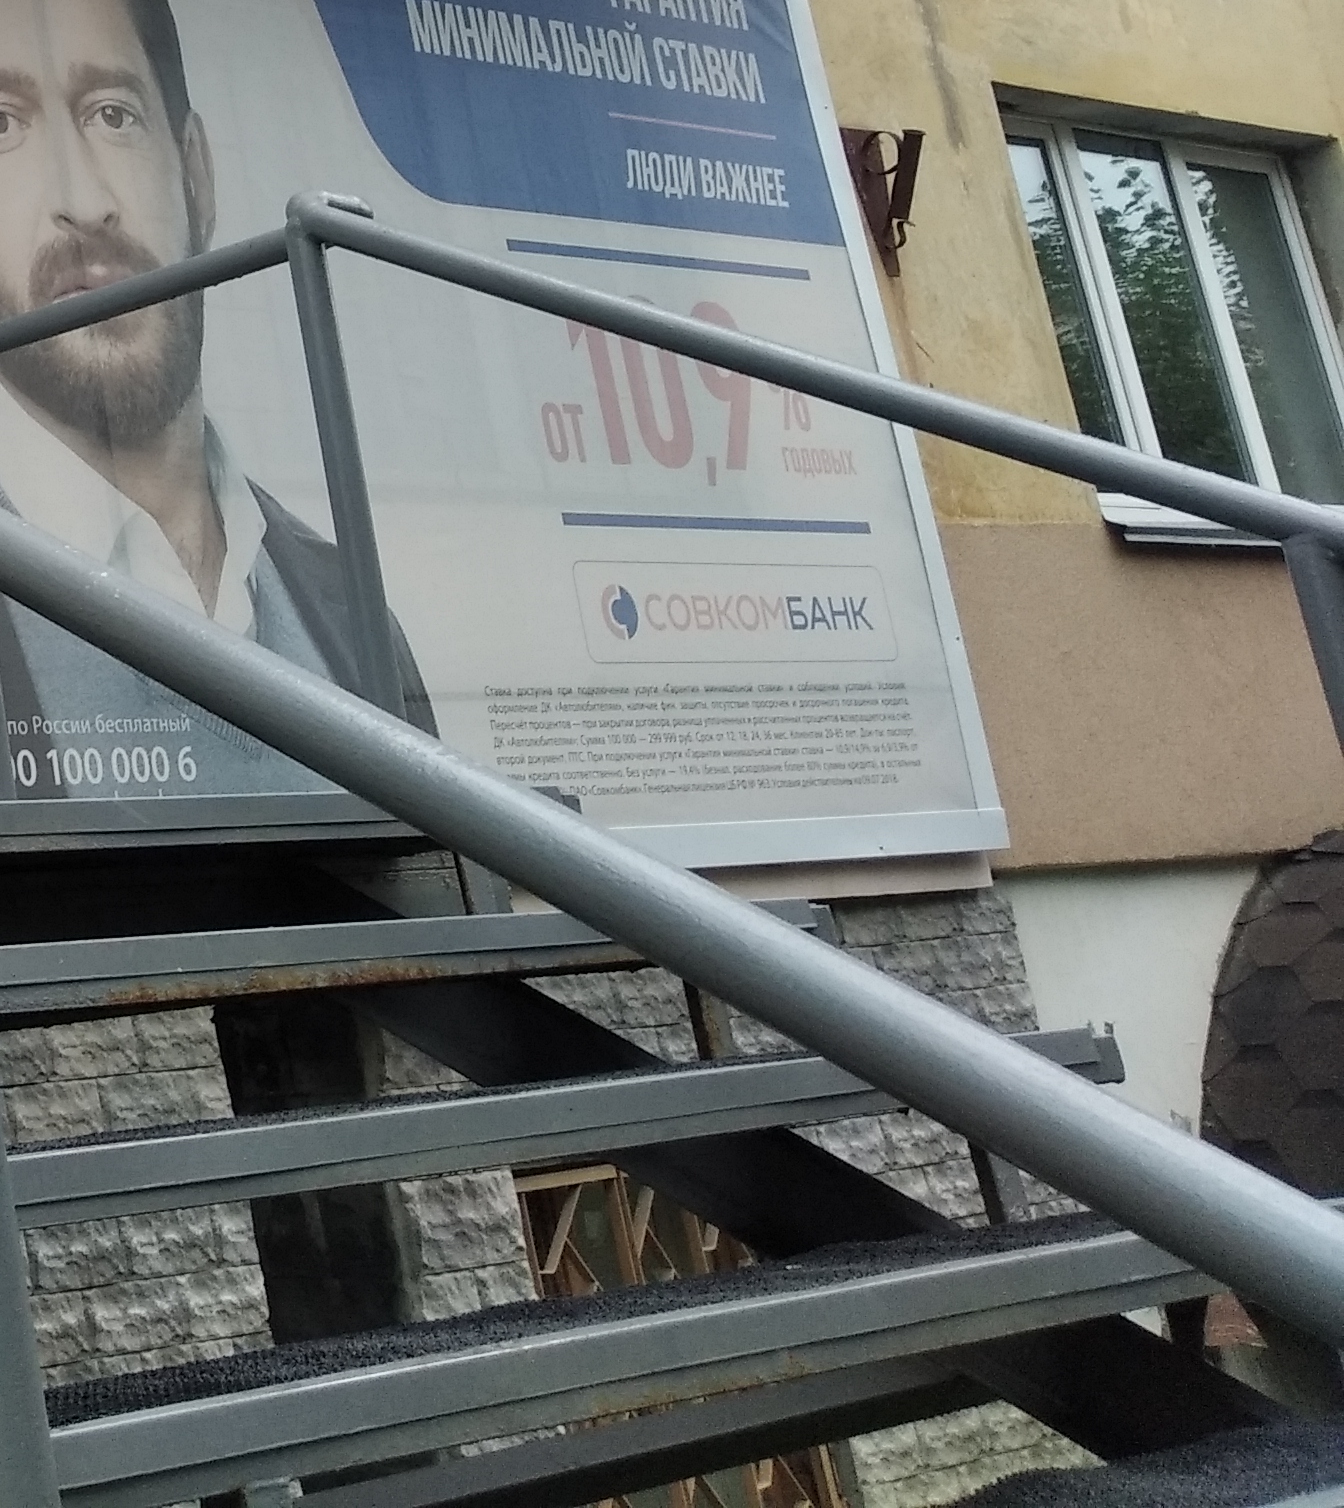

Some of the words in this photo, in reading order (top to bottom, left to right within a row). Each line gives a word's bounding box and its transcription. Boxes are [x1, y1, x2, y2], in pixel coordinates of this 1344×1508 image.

[652, 36, 767, 104] СТАВКИ
[624, 148, 697, 200] ЛЮДИ
[698, 158, 790, 208] ВАЖНЕЕ
[540, 401, 588, 464] ОТ
[781, 446, 858, 477] ГОДОВЫХ
[643, 592, 874, 632] СОВКОМБАНК
[7, 719, 29, 736] по
[31, 715, 91, 735] России
[94, 713, 191, 734] бесплатный
[46, 748, 104, 786] 100
[111, 746, 171, 784] 000
[177, 745, 198, 782] 6
